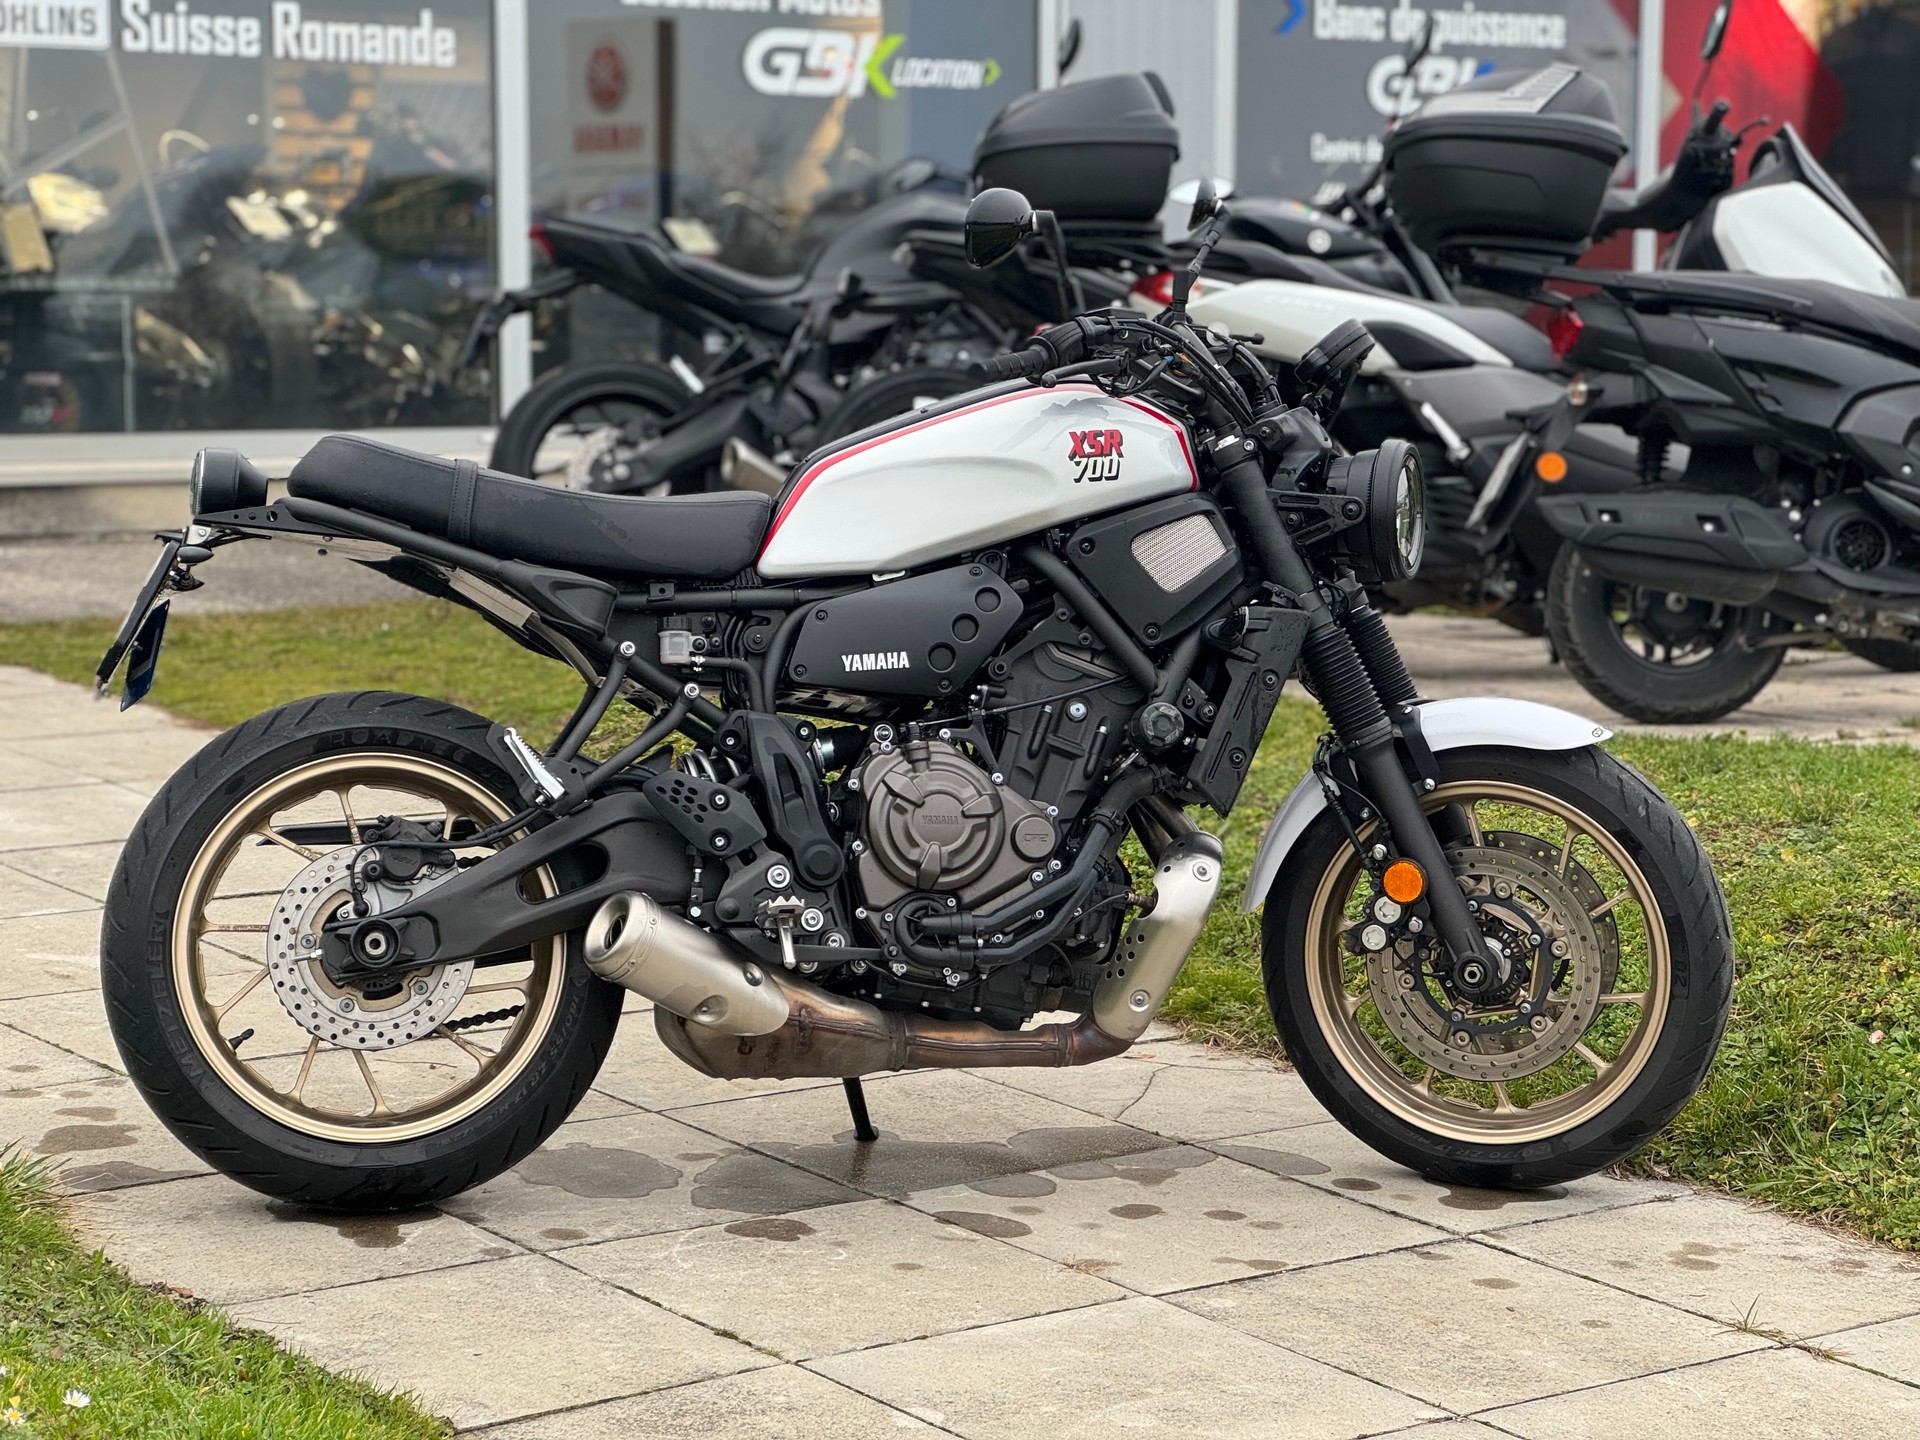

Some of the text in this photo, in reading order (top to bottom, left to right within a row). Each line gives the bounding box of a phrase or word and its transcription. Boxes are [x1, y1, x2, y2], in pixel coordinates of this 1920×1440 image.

[121, 0, 457, 67] Suisse Romande
[1430, 2, 1567, 53] puissance
[743, 26, 986, 98] GBK LOCATION
[1068, 429, 1124, 461] XSR
[1073, 456, 1121, 483] 700
[841, 651, 910, 672] YAMAHA
[922, 814, 959, 826] YAMAHA
